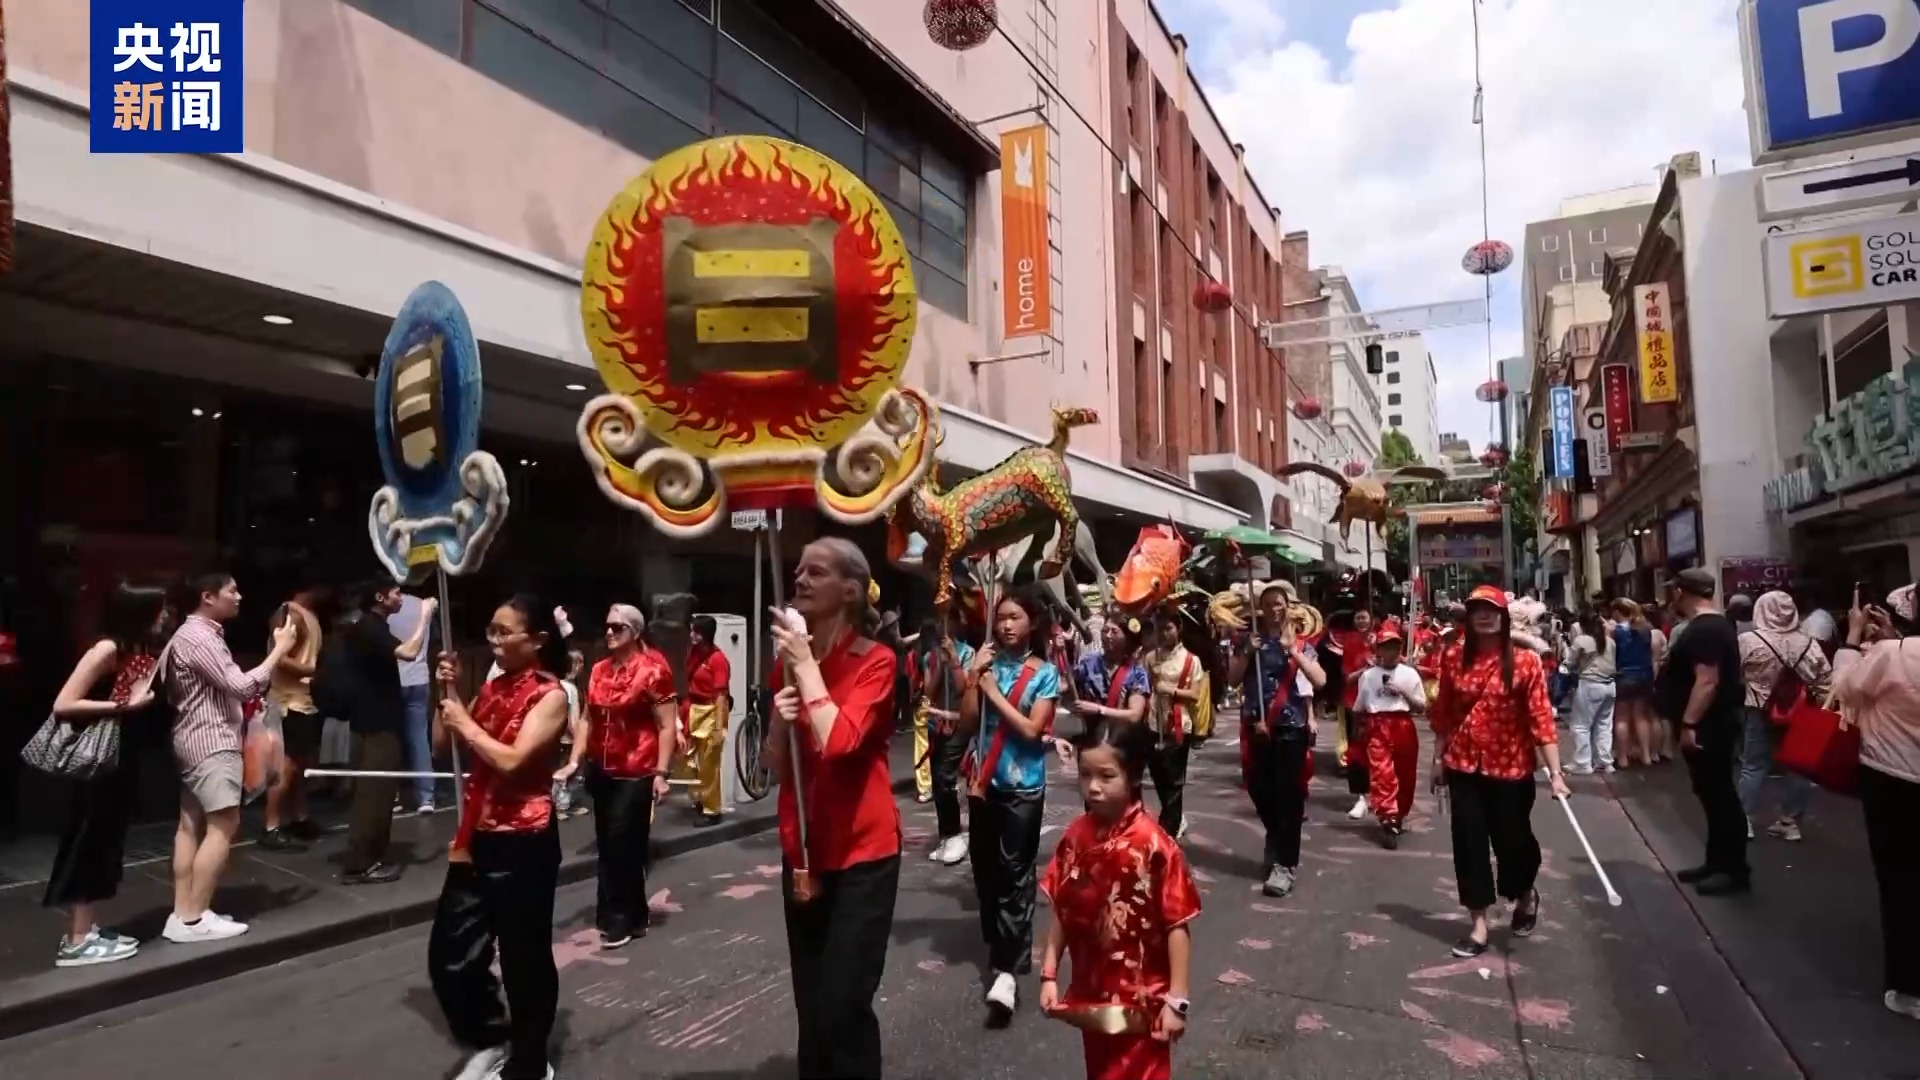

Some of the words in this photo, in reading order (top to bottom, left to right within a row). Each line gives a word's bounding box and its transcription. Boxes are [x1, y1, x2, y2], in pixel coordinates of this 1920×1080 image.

[1797, 0, 1920, 120] P
[1866, 231, 1920, 251] GOL
[1871, 267, 1918, 287] CAR
[1015, 257, 1035, 329] home
[1555, 393, 1571, 471] POKIES
